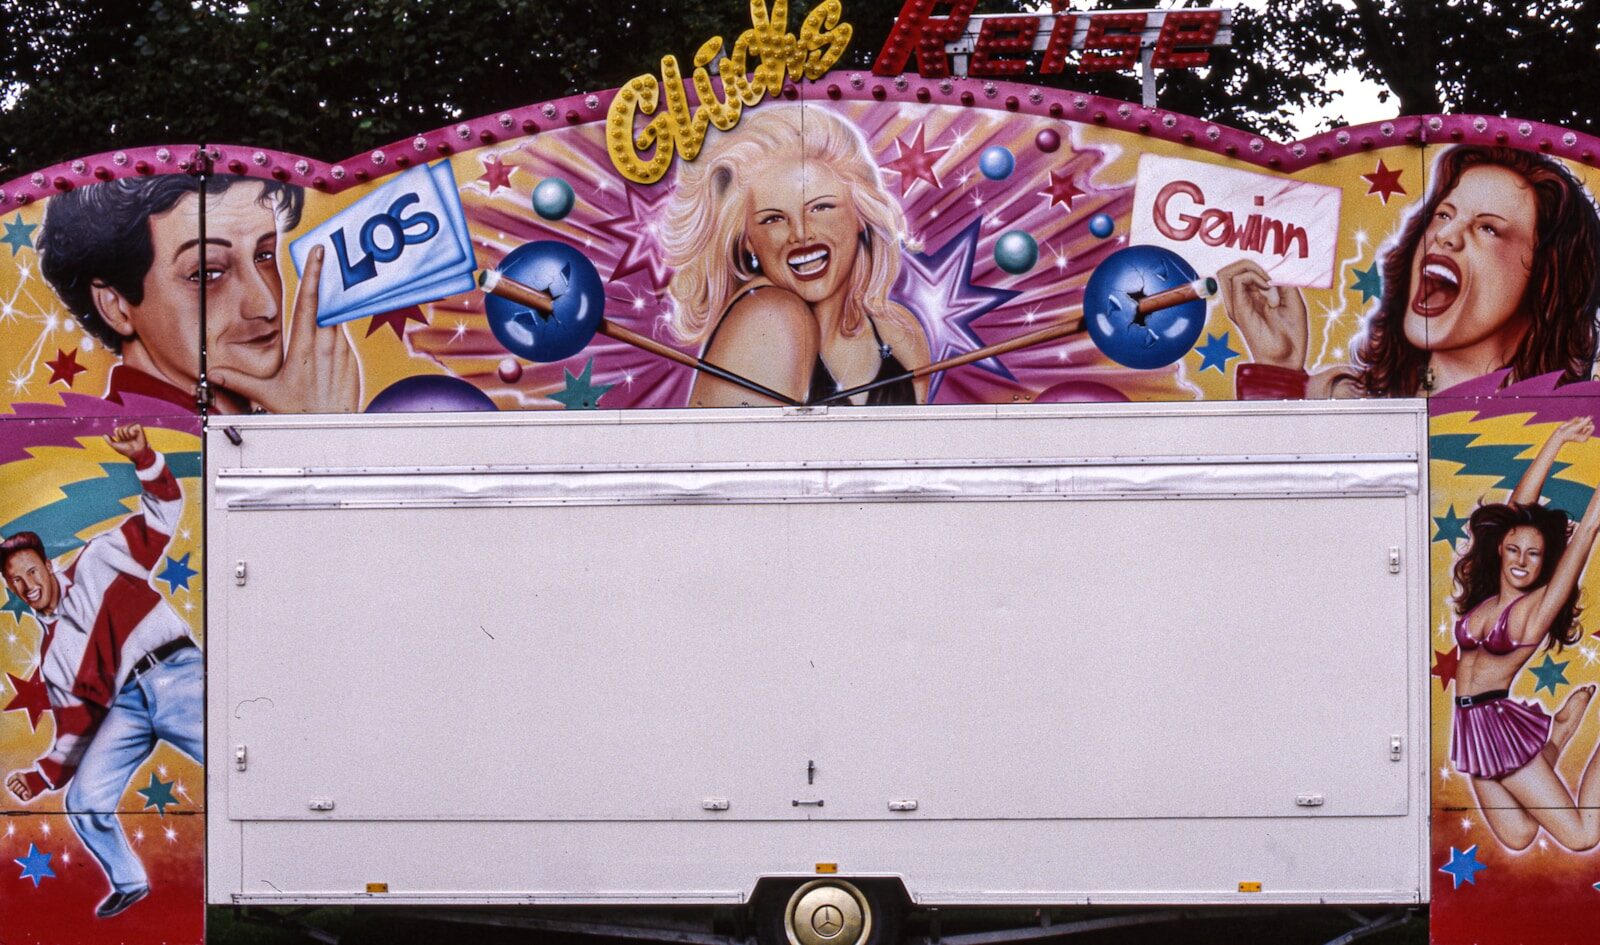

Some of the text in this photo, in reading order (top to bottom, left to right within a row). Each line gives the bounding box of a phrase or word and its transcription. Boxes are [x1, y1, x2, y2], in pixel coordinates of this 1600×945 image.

[872, 0, 1222, 78] Reise
[329, 192, 440, 292] LOS
[1152, 179, 1309, 259] Gewinn
